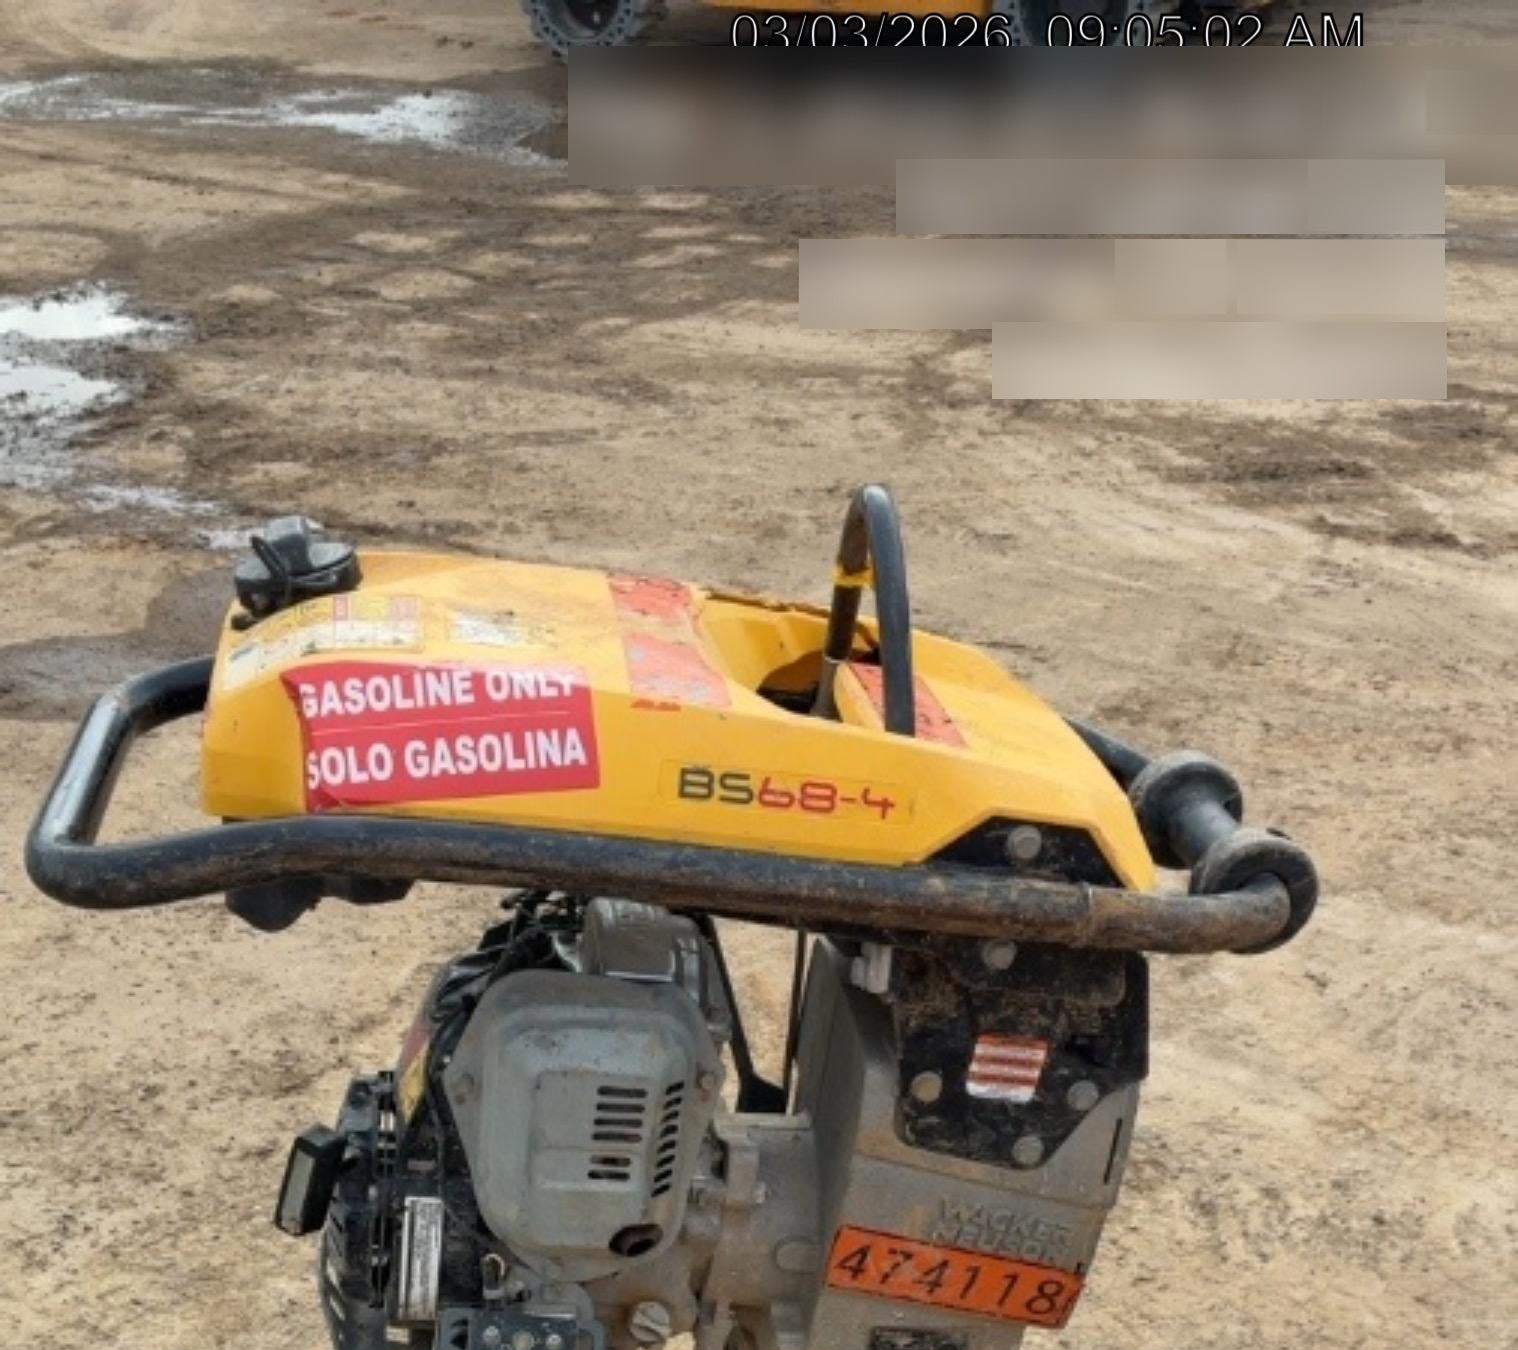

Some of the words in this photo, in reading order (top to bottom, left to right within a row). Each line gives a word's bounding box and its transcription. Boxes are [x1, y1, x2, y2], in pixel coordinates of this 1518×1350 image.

[299, 670, 475, 718] GASOLINE
[485, 670, 577, 700] ONLY
[404, 727, 588, 778] GASOLINA
[678, 767, 895, 820] BS68-4
[833, 1244, 1065, 1315] 474118
